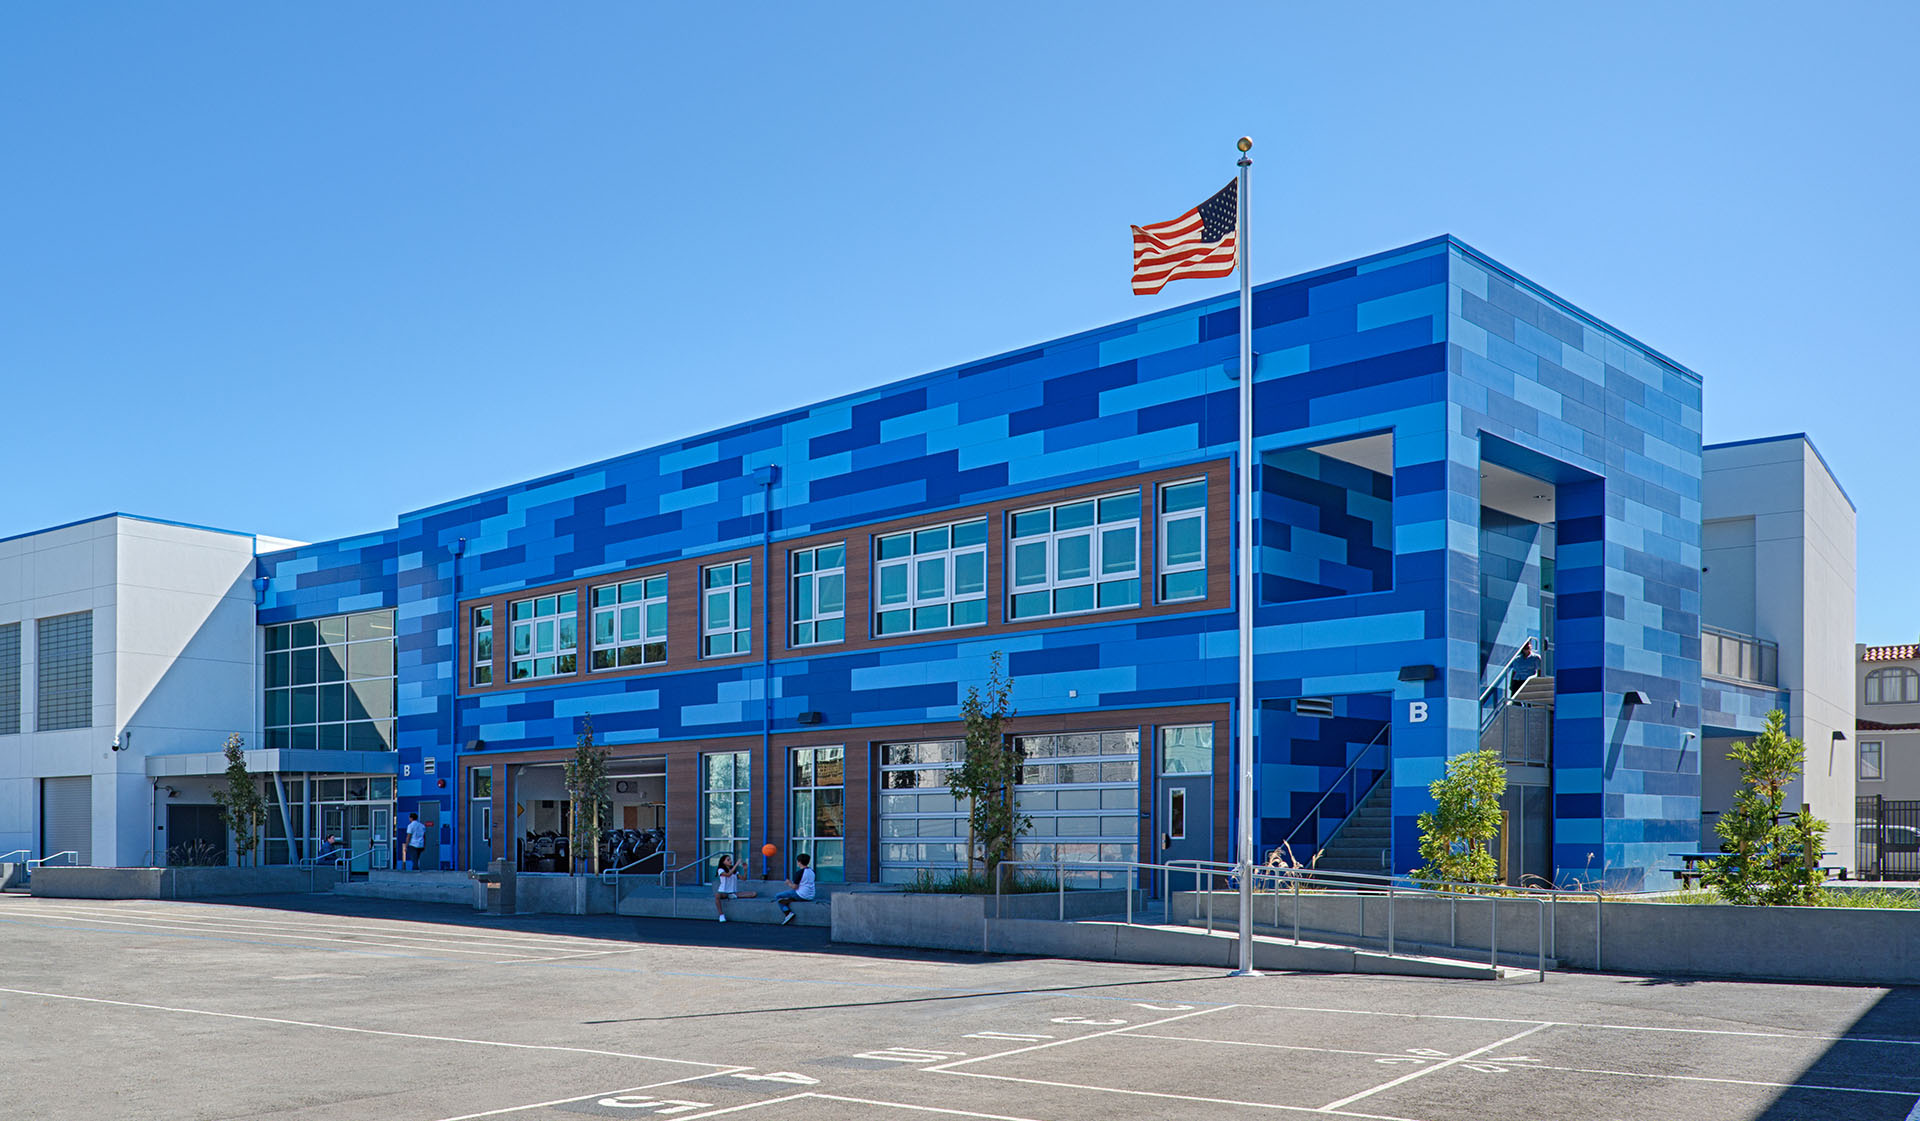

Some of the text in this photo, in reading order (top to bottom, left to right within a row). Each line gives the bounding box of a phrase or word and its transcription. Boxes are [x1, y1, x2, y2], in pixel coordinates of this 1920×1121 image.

[1409, 701, 1428, 723] B
[403, 764, 411, 777] B
[730, 1071, 820, 1085] 4
[597, 1095, 714, 1114] 5
